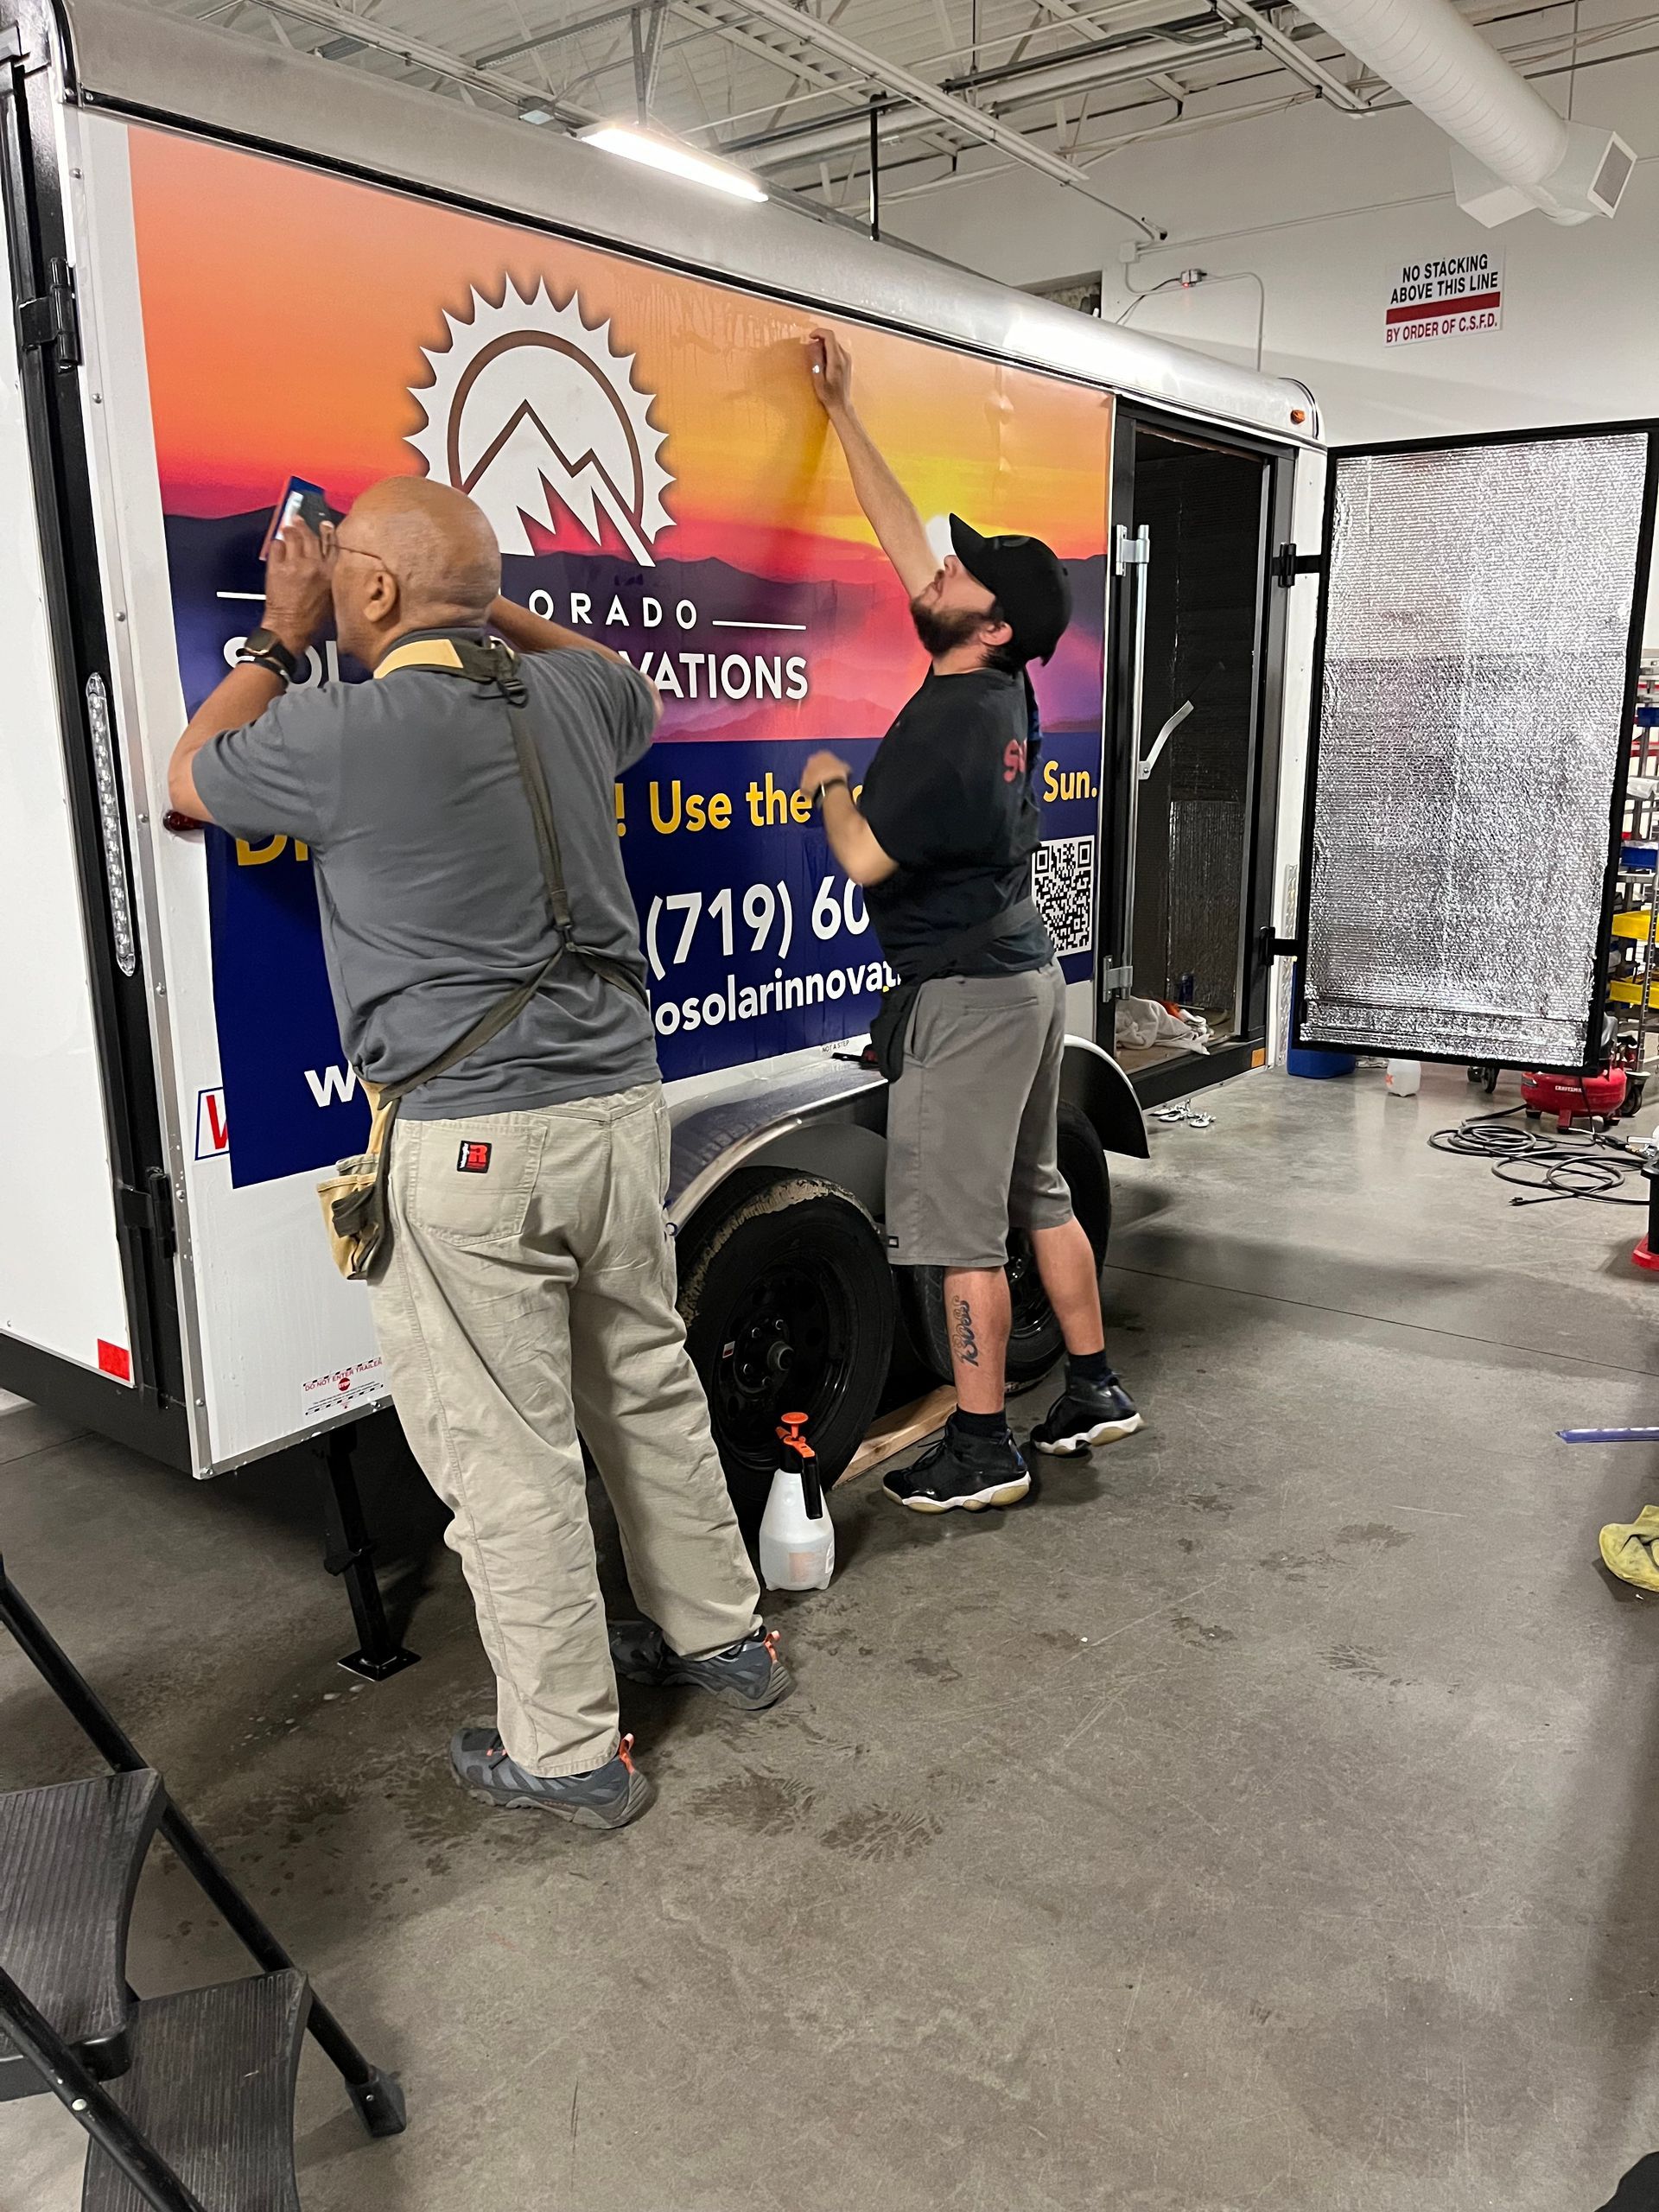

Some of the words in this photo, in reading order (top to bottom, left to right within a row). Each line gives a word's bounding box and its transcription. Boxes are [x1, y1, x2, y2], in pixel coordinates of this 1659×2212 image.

[1390, 283, 1433, 304] ABOVE
[1437, 277, 1465, 296] THIS
[1470, 271, 1498, 291] LINE
[1402, 265, 1420, 283] NO
[1424, 254, 1488, 278] STACKING
[1386, 327, 1400, 343] BY
[1402, 321, 1439, 340] ORDER
[1442, 319, 1456, 334] OF
[1459, 313, 1497, 332] C.S.F.D.
[528, 589, 697, 630] ORADO
[619, 651, 809, 700] VATIONS
[650, 780, 732, 835] Use
[746, 772, 812, 827] the
[1043, 760, 1097, 803] Sun.
[646, 880, 792, 981] (719)
[811, 875, 870, 940] 60
[304, 1060, 357, 1108] w
[646, 961, 901, 1035] osolarinnovat
[316, 1378, 330, 1387] NOT
[333, 1370, 353, 1382] ENTER
[356, 1359, 383, 1373] TRAILER
